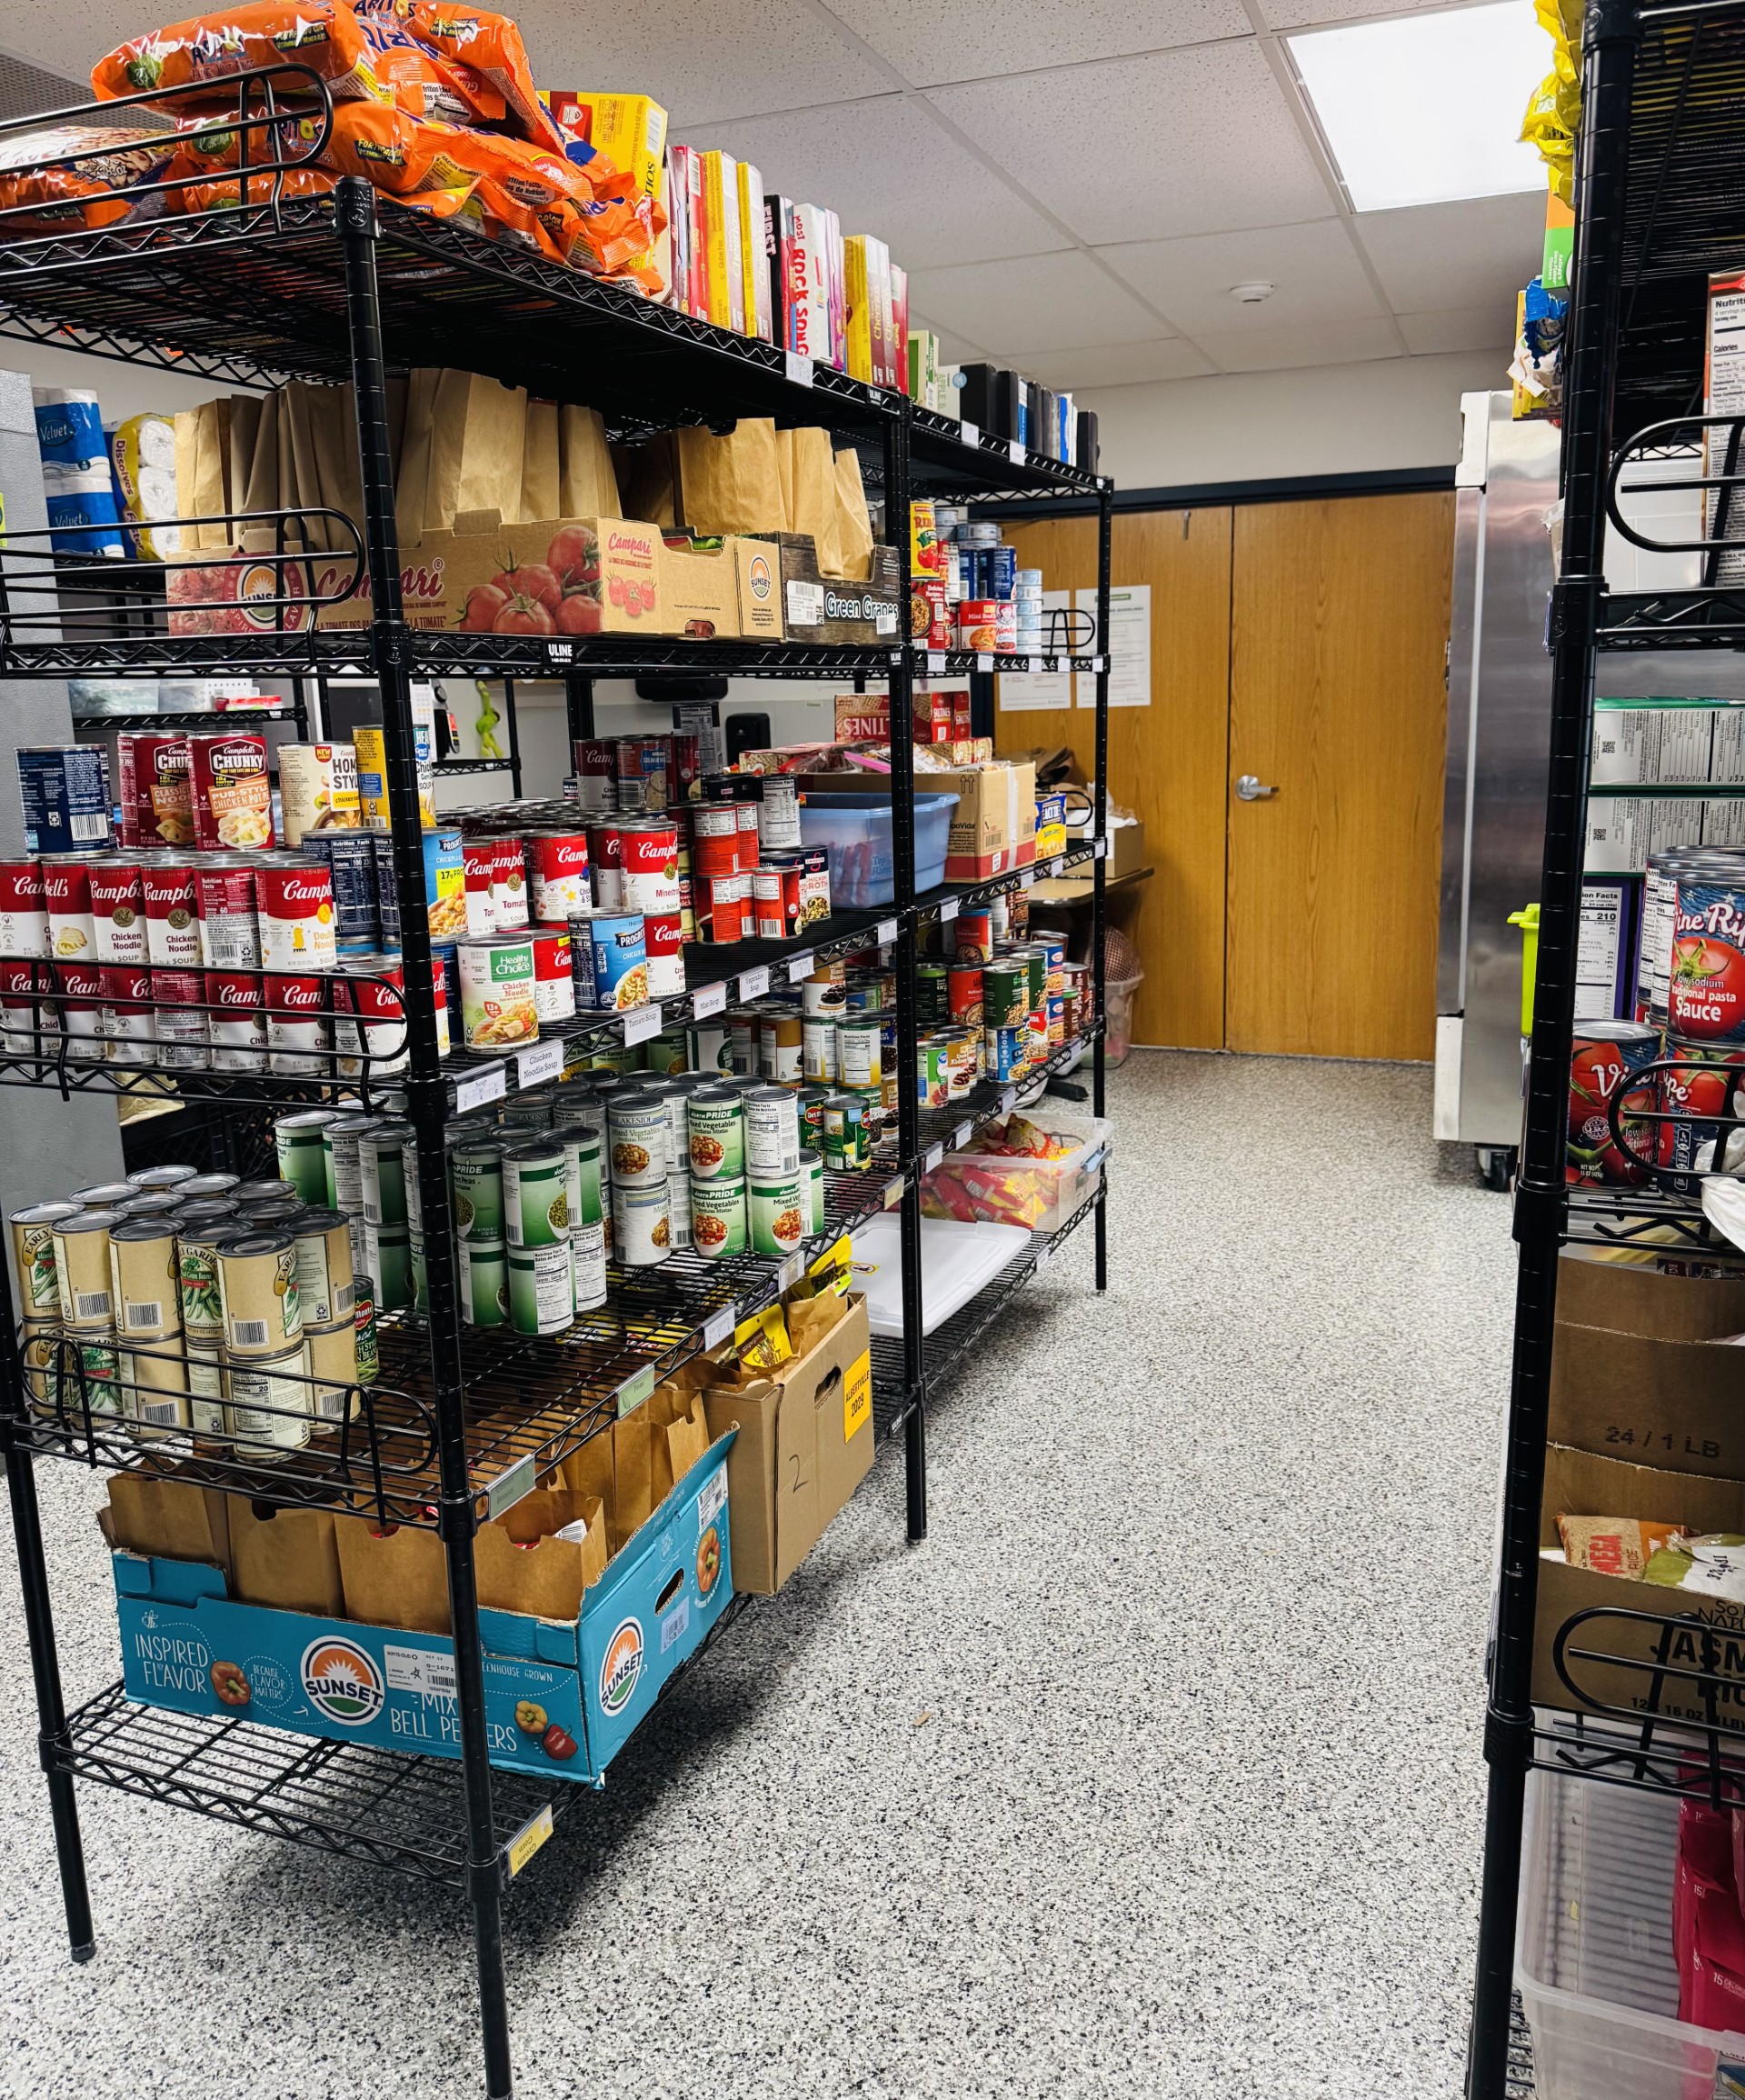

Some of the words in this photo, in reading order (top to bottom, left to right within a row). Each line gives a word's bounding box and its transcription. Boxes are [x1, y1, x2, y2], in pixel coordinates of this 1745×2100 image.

[793, 215, 805, 240] MOST
[793, 248, 807, 304] ROCK
[1715, 300, 1745, 309] Nutriti
[873, 285, 882, 341] Cheerios
[795, 306, 810, 355] SONG
[1714, 344, 1738, 354] Calories
[40, 424, 68, 442] Velvet
[115, 439, 135, 496] Dissolves
[55, 514, 83, 527] Velvet
[914, 515, 932, 528] RED
[608, 532, 652, 556] Campari
[316, 566, 445, 610] Camari
[751, 577, 771, 589] SUNSET
[825, 591, 861, 618] Green
[862, 594, 899, 622] Grapes
[548, 643, 573, 656] ULINE
[167, 746, 187, 755] Camp
[223, 745, 255, 755] Campbell's
[157, 755, 189, 770] CHU
[213, 754, 264, 770] CHUNKY
[333, 758, 356, 773] HOM
[334, 775, 359, 790] STYL
[155, 786, 187, 798] CLASSIC
[212, 784, 269, 800] PUB-STYLE
[335, 795, 354, 804] chicken
[214, 795, 248, 810] CHICKEN
[249, 793, 262, 804] POT
[443, 837, 463, 852] PROGRE
[638, 840, 678, 862] Campb
[556, 846, 588, 865] Camp
[89, 879, 143, 904] Campb
[143, 880, 197, 905] Campb
[282, 879, 334, 904] Campb
[502, 899, 527, 909] Tomato
[1596, 912, 1617, 921] 210
[1676, 908, 1705, 933] ine
[1707, 902, 1745, 948] Rip
[111, 933, 142, 942] Chicken
[165, 935, 198, 945] Chicken
[620, 930, 646, 947] PROGRE
[113, 942, 142, 950] Noodle
[168, 945, 197, 953] Noodle
[172, 956, 195, 965] SOUP
[500, 954, 529, 967] Healthy
[623, 951, 643, 961] CHICKEN
[495, 961, 532, 975] Choice
[502, 981, 530, 991] Chicken
[1677, 973, 1690, 985] low
[1690, 976, 1724, 989] sodium
[504, 988, 530, 997] Noodle
[1709, 991, 1737, 1003] pasta
[1675, 996, 1721, 1022] Sauce
[629, 1017, 643, 1028] Tomato
[644, 1013, 657, 1024] Soup
[529, 1051, 553, 1065] Chicken
[524, 1065, 543, 1078] Noodle
[544, 1060, 558, 1072] Soup
[706, 1110, 733, 1119] PRIDE
[612, 1128, 628, 1136] Mixed
[629, 1126, 662, 1137] Vegetables
[702, 1120, 736, 1131] Vegetables
[457, 1165, 484, 1175] PRIDE
[463, 1175, 476, 1185] Peas
[709, 1189, 735, 1199] PRIDE
[705, 1200, 740, 1210] Vegetables
[773, 1198, 787, 1206] Mixed
[25, 1227, 50, 1255] EARLY
[186, 1246, 218, 1265] GARDE
[198, 1272, 213, 1280] Beans
[233, 1385, 251, 1393] Calories
[844, 1369, 870, 1405] ALBERTVILLE
[850, 1395, 865, 1418] 2029
[1605, 1425, 1635, 1446] 24
[1642, 1430, 1652, 1447] /
[1661, 1433, 1672, 1450] 1
[1685, 1435, 1720, 1458] LB
[789, 1454, 809, 1494] 2
[1628, 1549, 1639, 1571] RICE
[135, 1633, 208, 1668] INSPIRED
[386, 1650, 401, 1658] sam's
[401, 1652, 413, 1660] club
[144, 1661, 207, 1695] FLAVOR
[253, 1664, 280, 1679] BECAUSE
[482, 1661, 521, 1678] EENHOUSE
[524, 1668, 553, 1683] GROWN
[250, 1675, 285, 1690] FLAVOR
[601, 1650, 644, 1710] SUNSET
[254, 1686, 284, 1701] MATTERS
[305, 1677, 384, 1709] SUNSET
[421, 1691, 456, 1715] MIX
[1664, 1705, 1681, 1717] 16
[1685, 1709, 1704, 1721] OZ
[391, 1709, 432, 1740] BELL
[442, 1716, 518, 1753] PEERS
[1693, 1884, 1703, 1896] 15
[1713, 1972, 1724, 1986] 15
